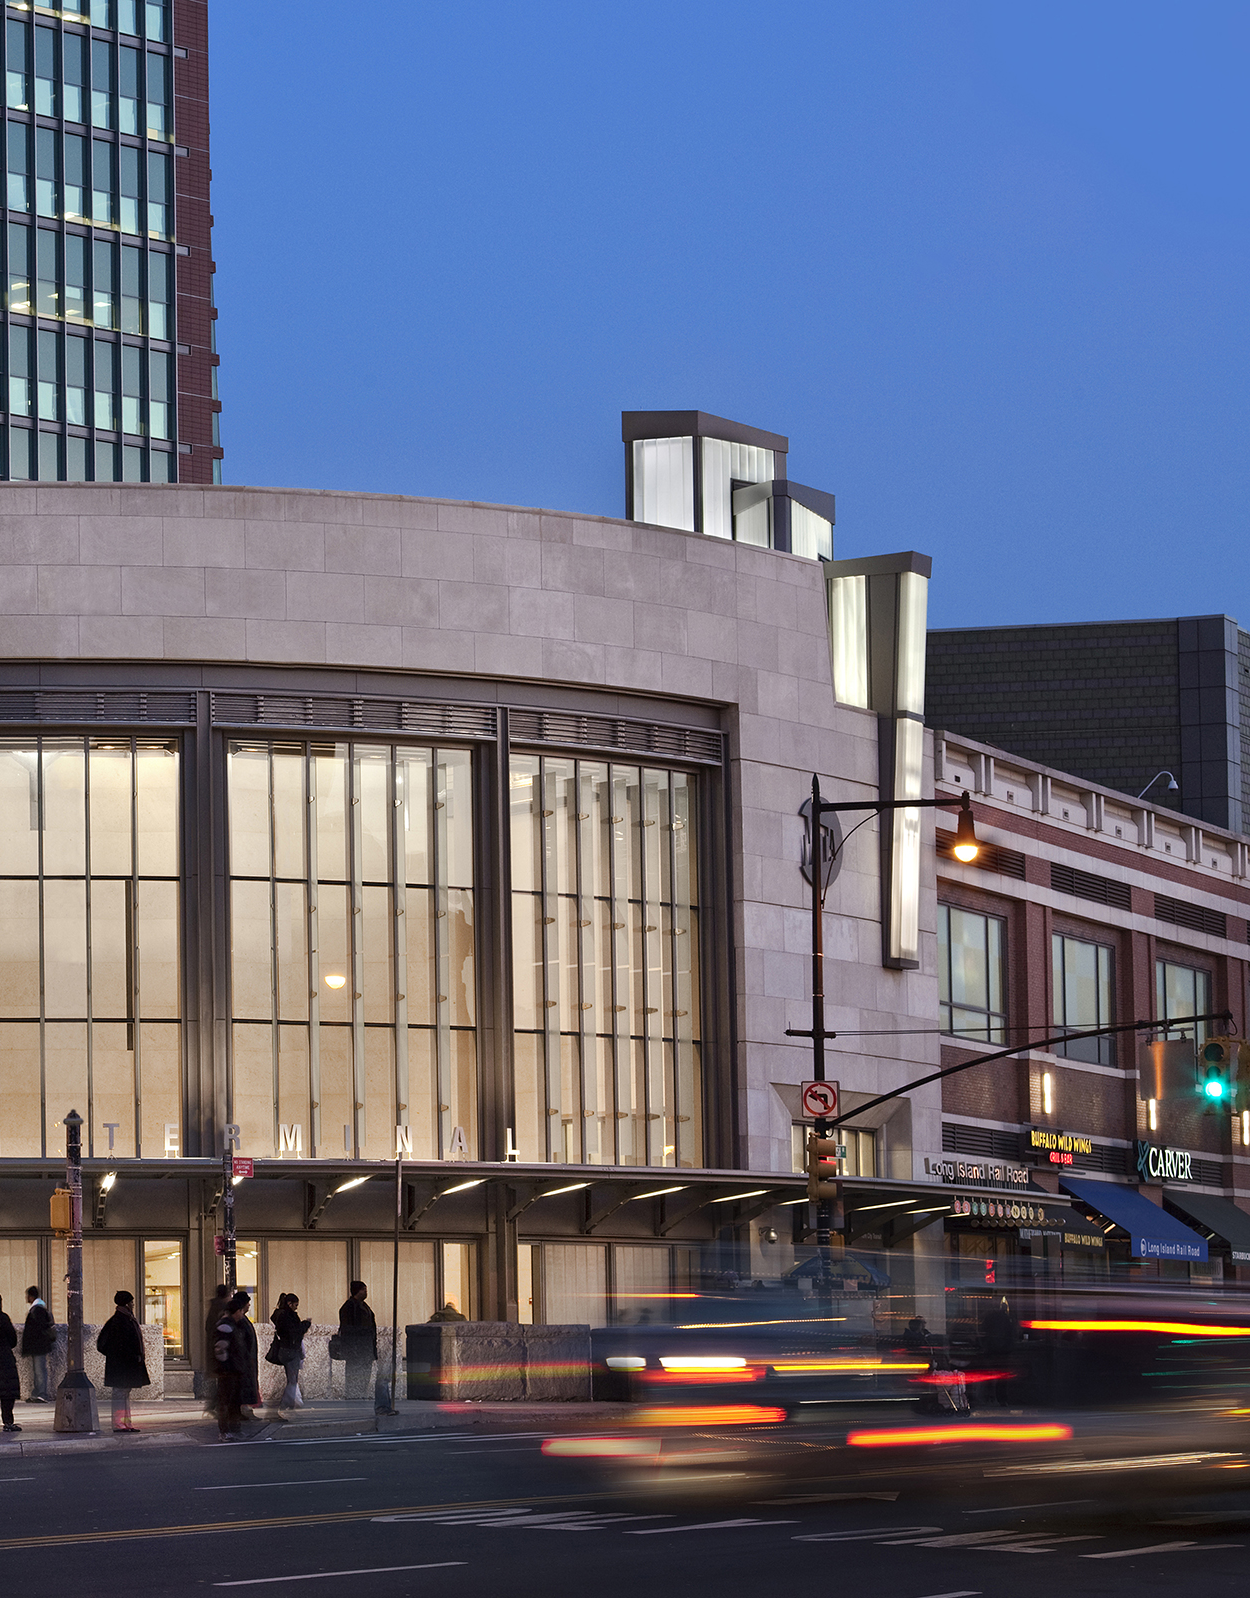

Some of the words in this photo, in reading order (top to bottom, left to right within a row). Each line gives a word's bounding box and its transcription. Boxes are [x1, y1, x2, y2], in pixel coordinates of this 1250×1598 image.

[102, 1123, 520, 1155] TERMINAL
[1031, 1130, 1057, 1150] BUFFALO
[1058, 1135, 1072, 1152] WILD
[1074, 1137, 1092, 1154] WINGS
[924, 1157, 955, 1180] Long
[957, 1161, 985, 1179] Island
[988, 1164, 1004, 1182] Rail
[1007, 1166, 1029, 1184] Road
[1149, 1147, 1193, 1180] CARVER
[1148, 1241, 1160, 1256] Long
[1161, 1243, 1176, 1255] Island
[1177, 1244, 1187, 1256] Rail
[1188, 1245, 1200, 1257] Road
